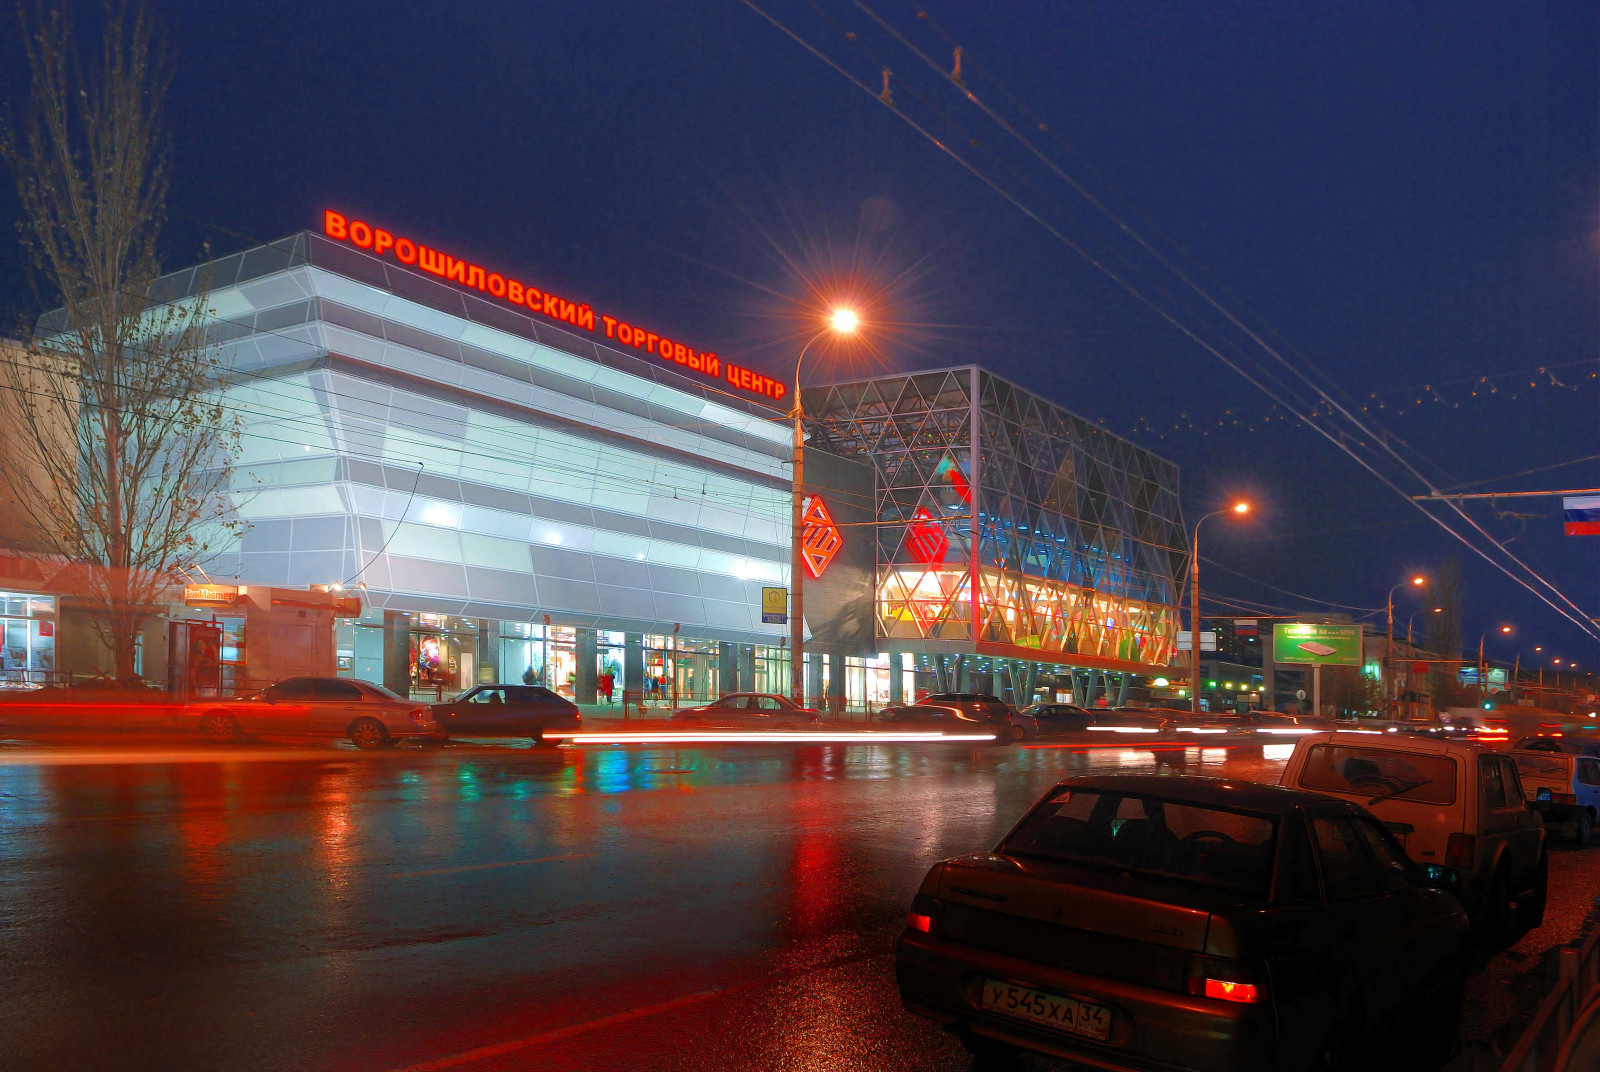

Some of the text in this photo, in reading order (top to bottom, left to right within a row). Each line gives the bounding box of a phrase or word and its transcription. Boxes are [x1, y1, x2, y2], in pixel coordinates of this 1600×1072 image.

[324, 209, 786, 400] ВОРОШИЛОВСКИЙ ТОРГОВЫЙ ЦЕНТР
